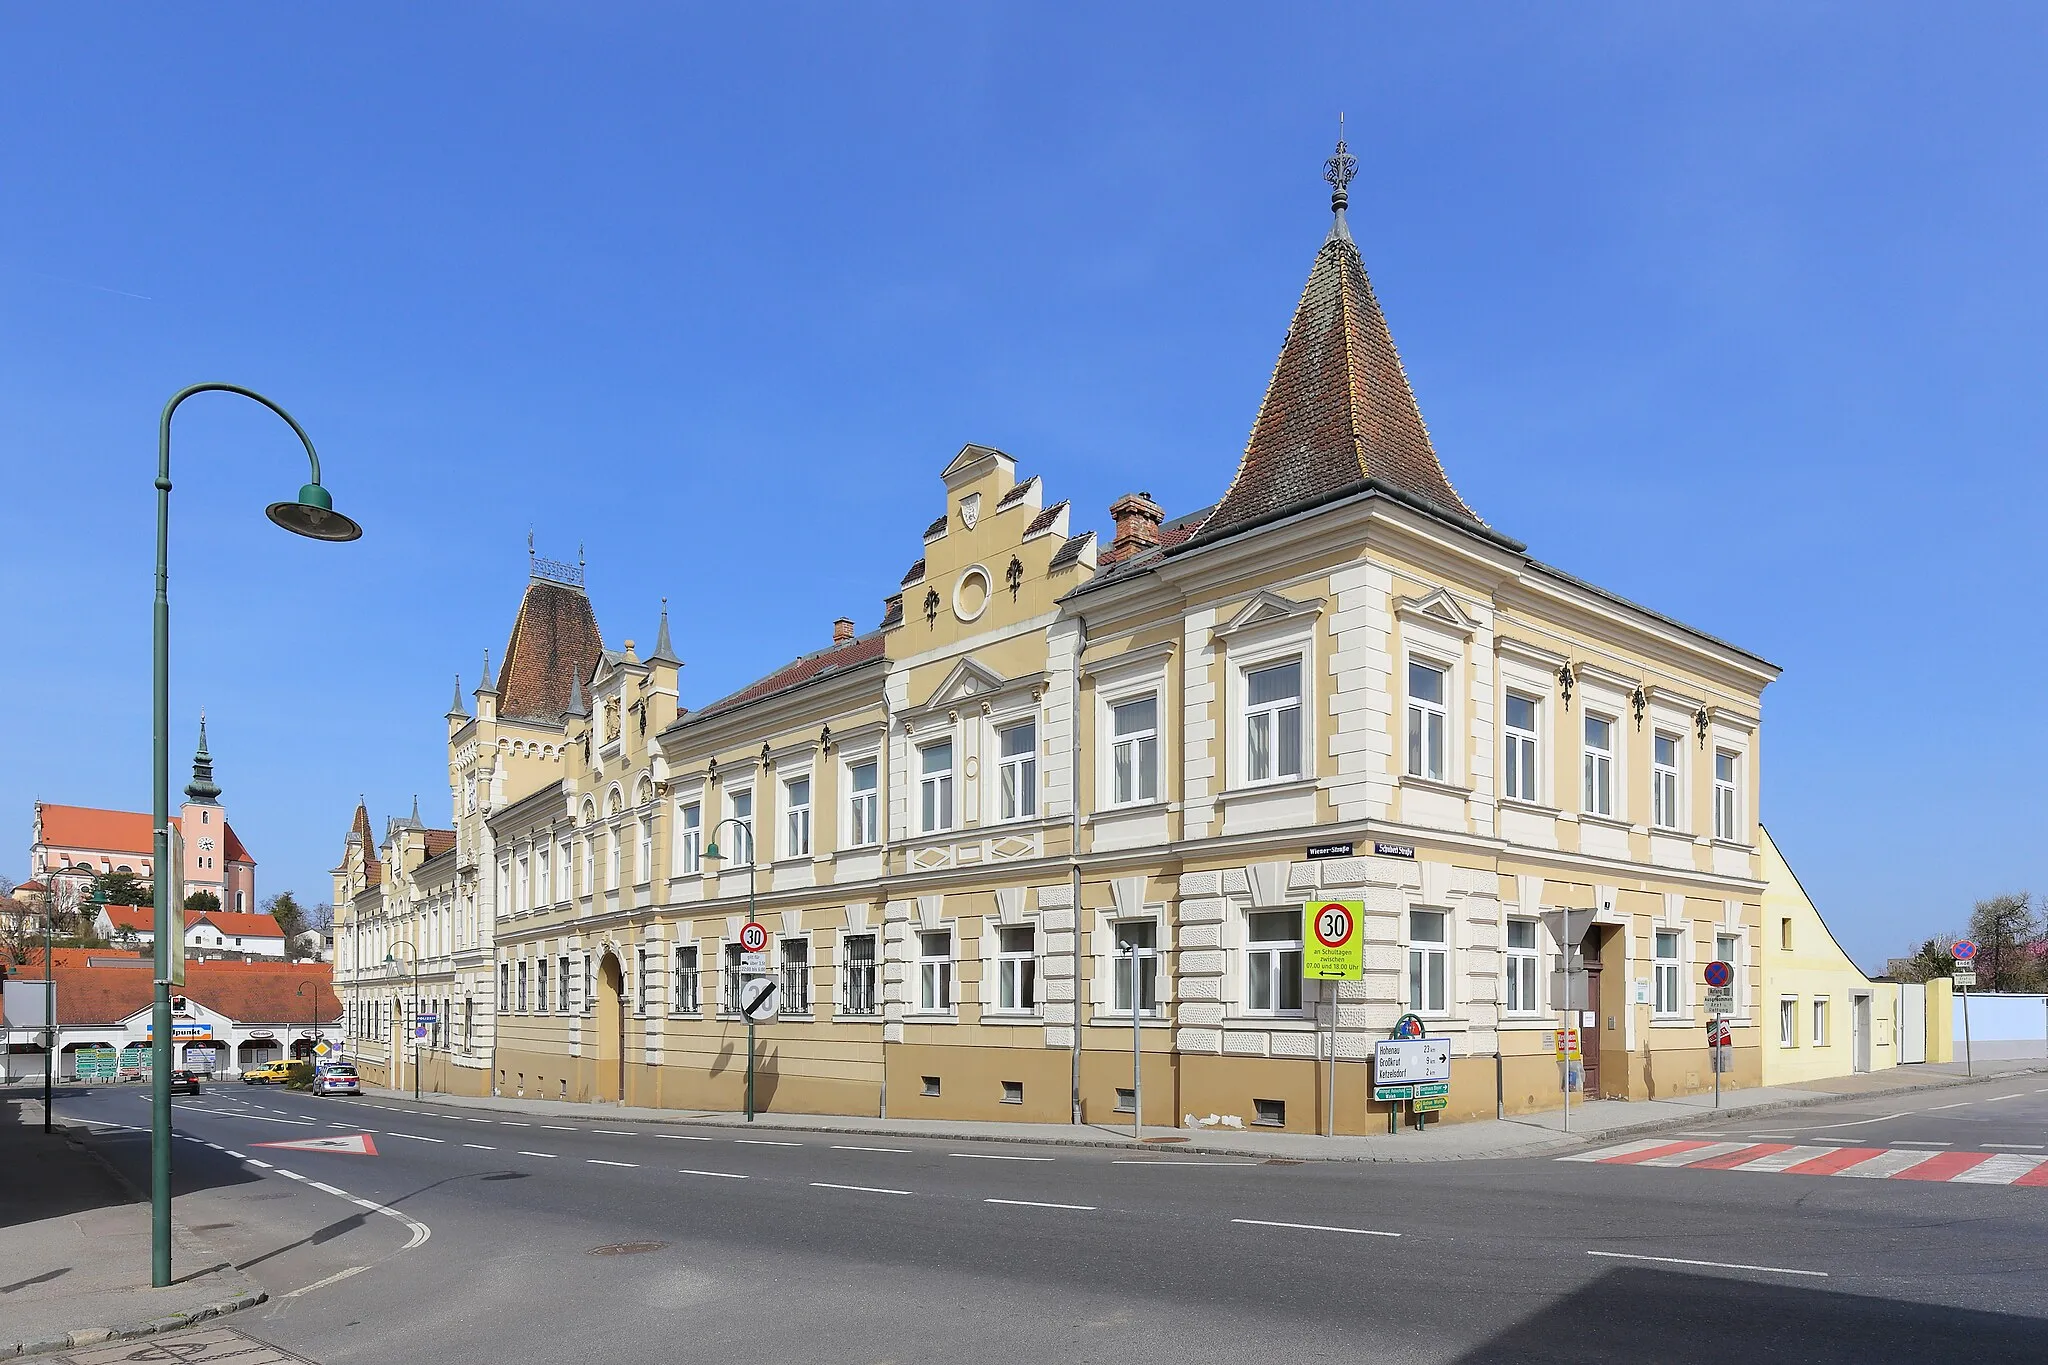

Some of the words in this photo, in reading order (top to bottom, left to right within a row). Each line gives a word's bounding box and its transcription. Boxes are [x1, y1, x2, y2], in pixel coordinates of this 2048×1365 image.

[1309, 846, 1350, 855] Wiener-Straße
[1323, 914, 1345, 937] 30
[747, 929, 760, 945] 30
[1380, 1046, 1400, 1055] Hohenau
[1424, 1045, 1430, 1053] 23
[1426, 1068, 1430, 1076] 2
